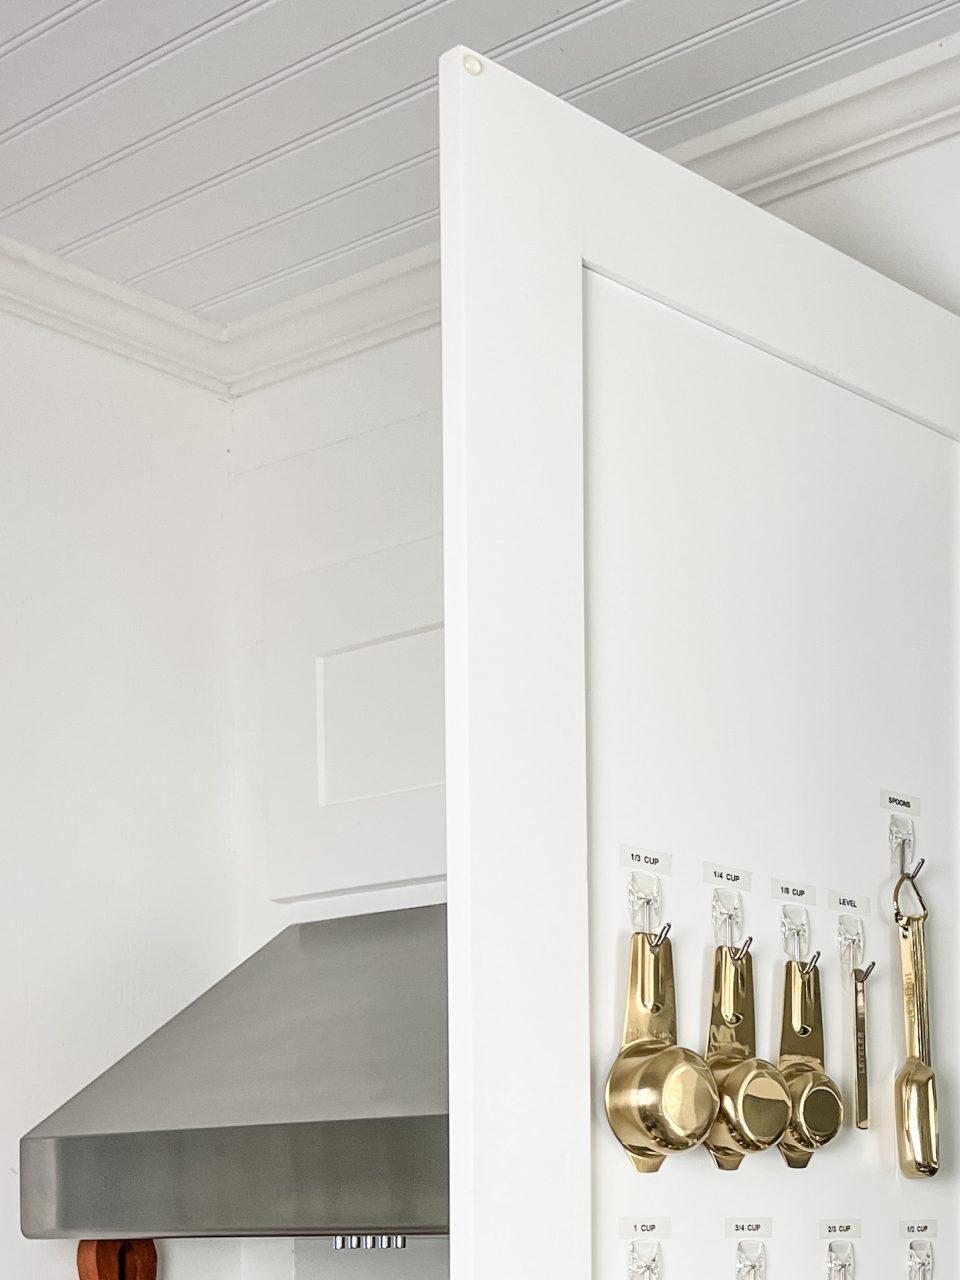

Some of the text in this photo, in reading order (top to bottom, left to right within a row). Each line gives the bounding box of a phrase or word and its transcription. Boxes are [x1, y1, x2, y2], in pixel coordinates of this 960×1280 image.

[888, 796, 911, 809] SPOONS
[630, 853, 660, 866] 1/3 CUP
[713, 871, 740, 882] 1/4 CUP
[780, 886, 805, 898] 1/8 CUP
[838, 898, 858, 908] LEVEL
[641, 1224, 656, 1232] CUP
[734, 1224, 761, 1232] 3/4 CUP
[827, 1225, 851, 1233] 2/3 CUP
[906, 1225, 928, 1233] 1/2 CUP
